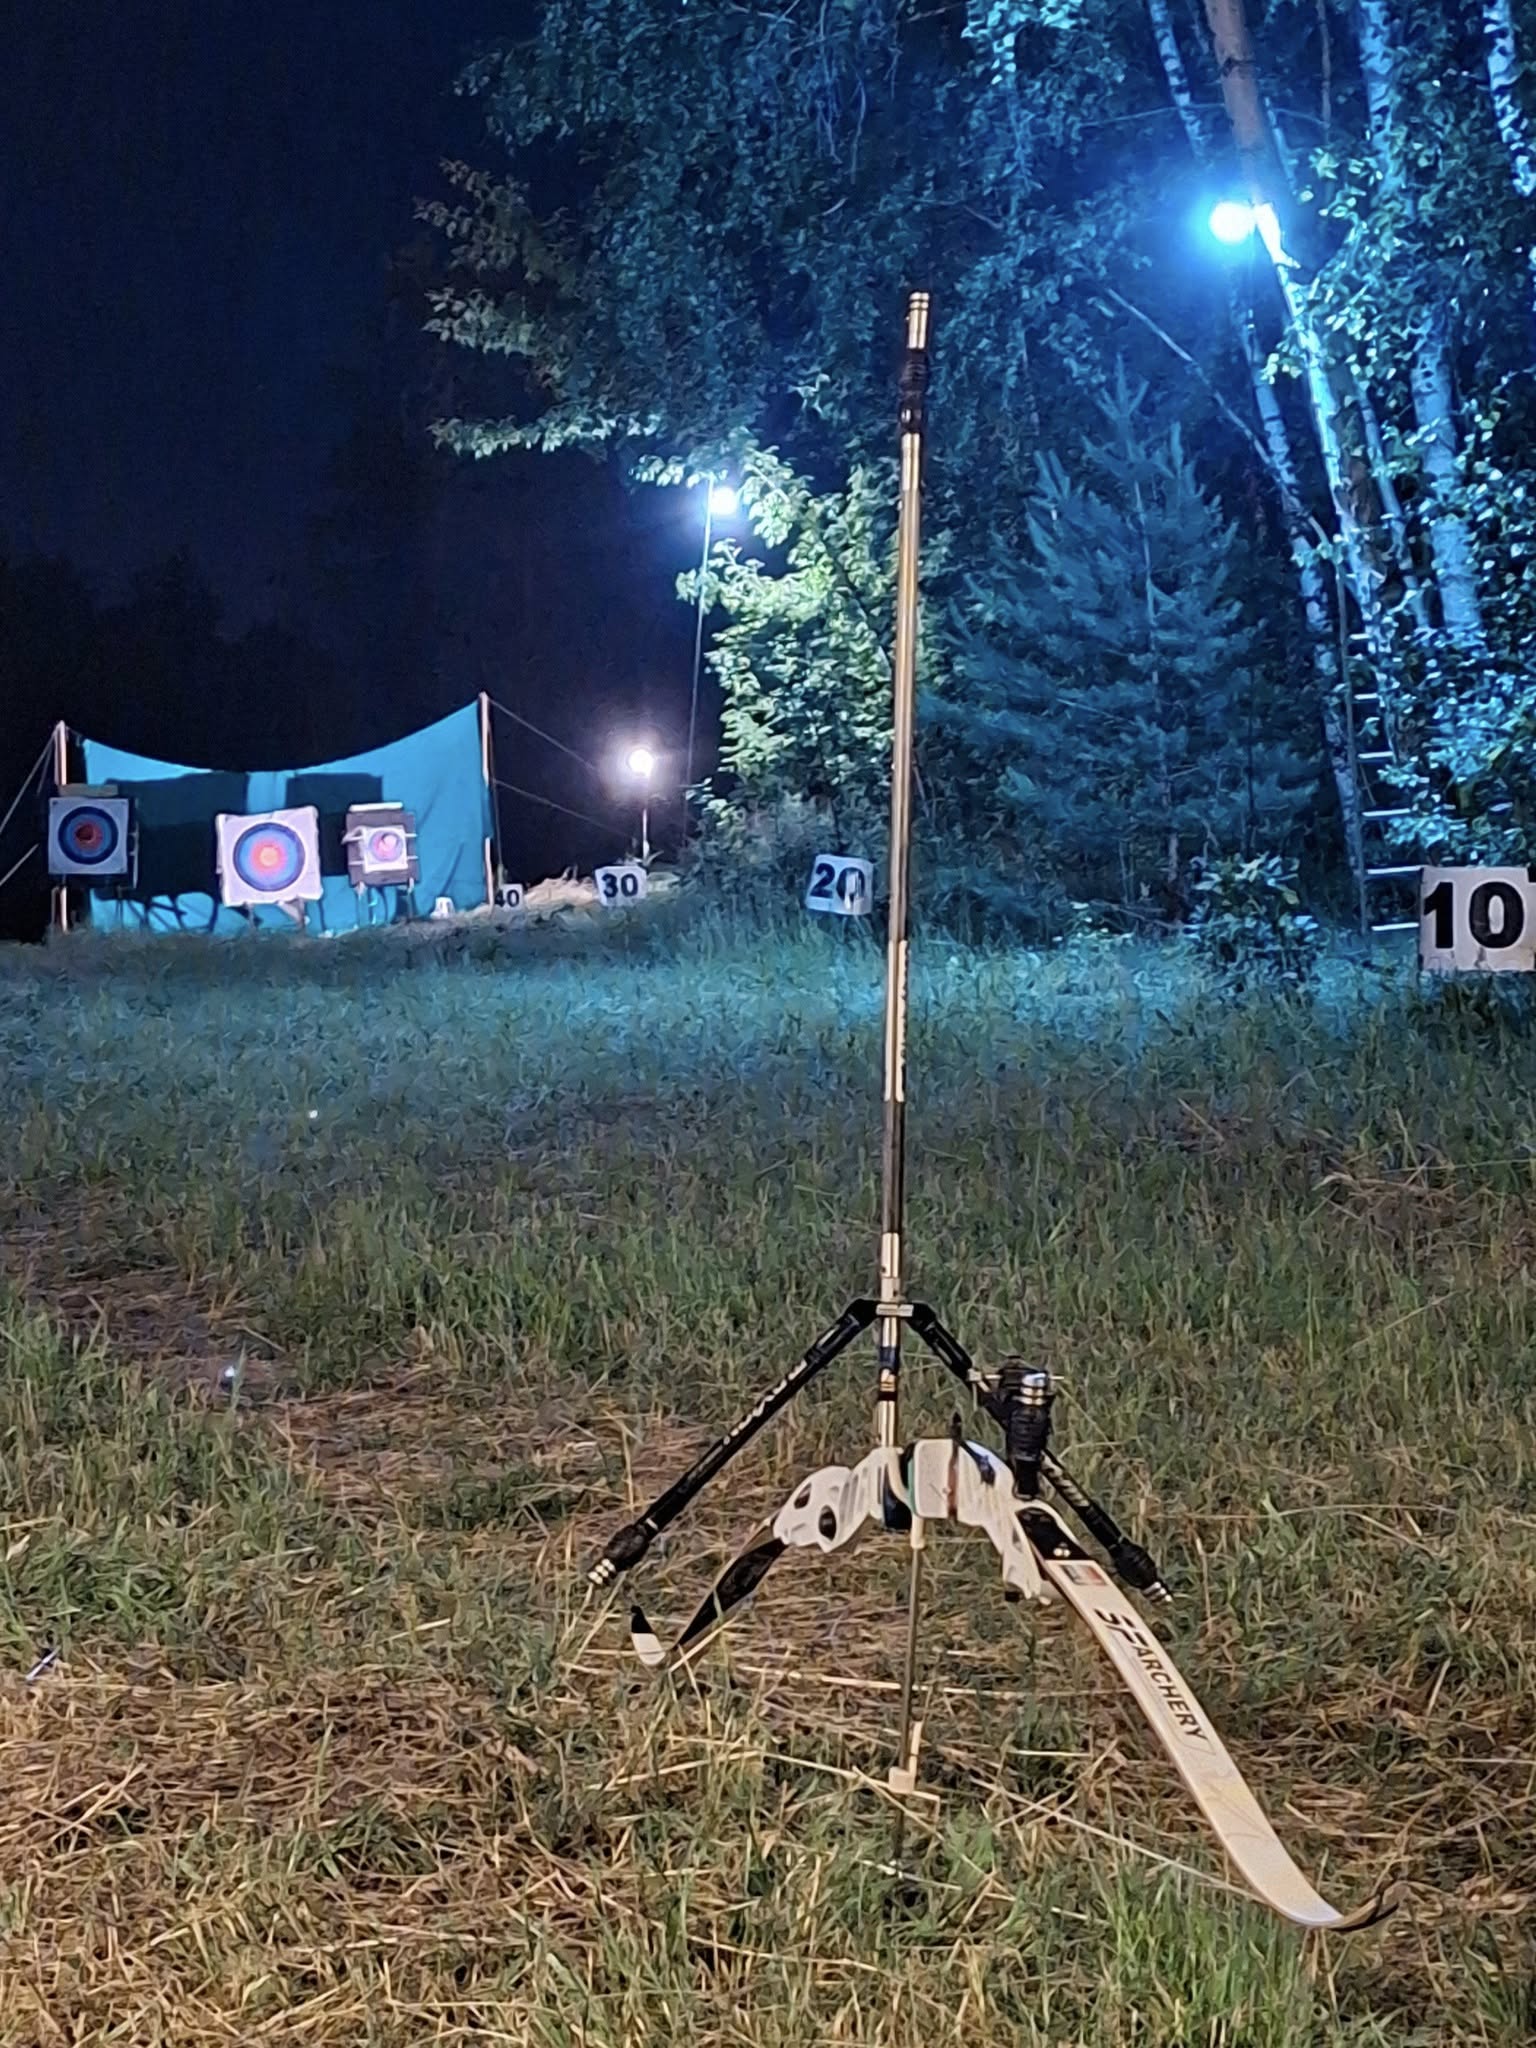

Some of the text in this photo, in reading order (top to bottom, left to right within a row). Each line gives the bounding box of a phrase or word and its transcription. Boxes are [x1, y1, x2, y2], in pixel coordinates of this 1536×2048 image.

[602, 873, 638, 898] 30
[810, 863, 865, 902] 20
[1424, 881, 1525, 949] 10
